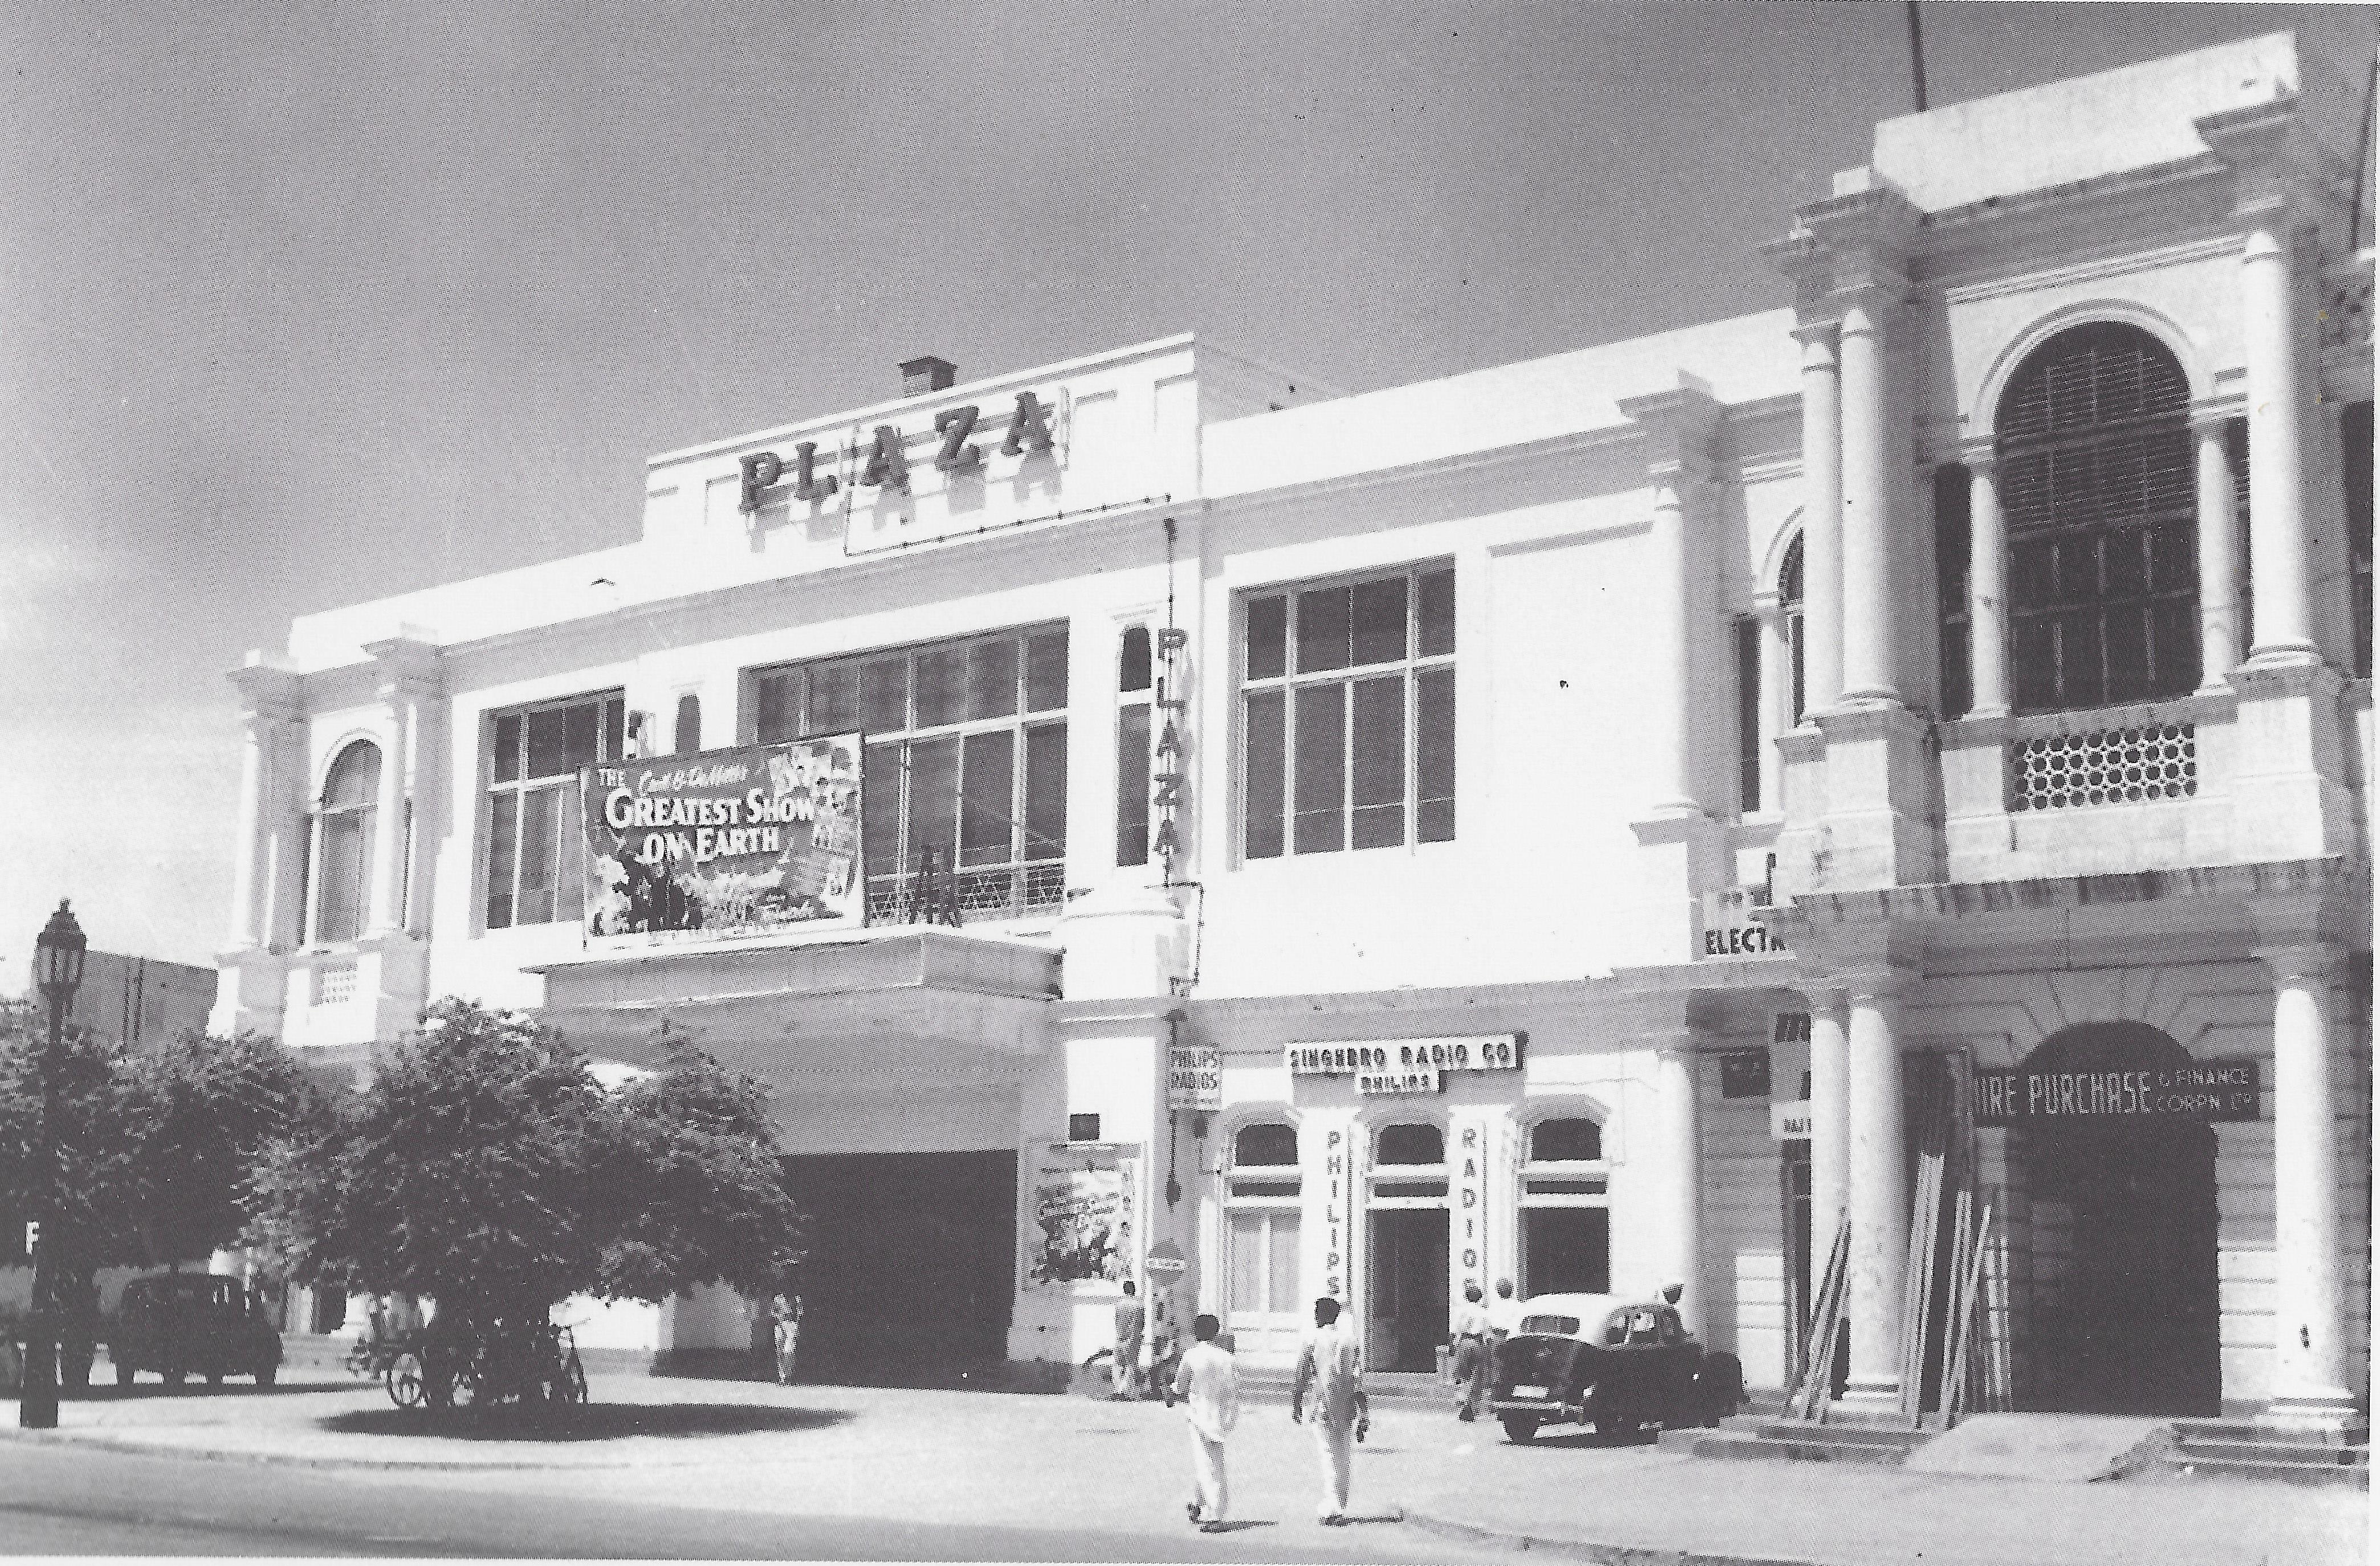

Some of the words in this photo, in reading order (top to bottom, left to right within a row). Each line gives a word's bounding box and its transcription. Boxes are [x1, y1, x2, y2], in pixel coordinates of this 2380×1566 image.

[739, 391, 1054, 514] PLAZA
[1153, 628, 1187, 854] PLAZA
[598, 768, 626, 787] THE
[605, 787, 742, 829] GREATEST
[747, 787, 814, 824] SHOW
[642, 831, 685, 864] ON
[696, 826, 780, 863] EARTH
[1400, 1044, 1468, 1065] RADIO
[1482, 1042, 1510, 1062] CO
[1361, 1074, 1431, 1089] PHILIPS
[2028, 1071, 2152, 1115] PURCHASE
[2175, 1068, 2249, 1087] FINANCE
[2157, 1094, 2221, 1112] CORPN
[1327, 1131, 1341, 1296] PHILIPS
